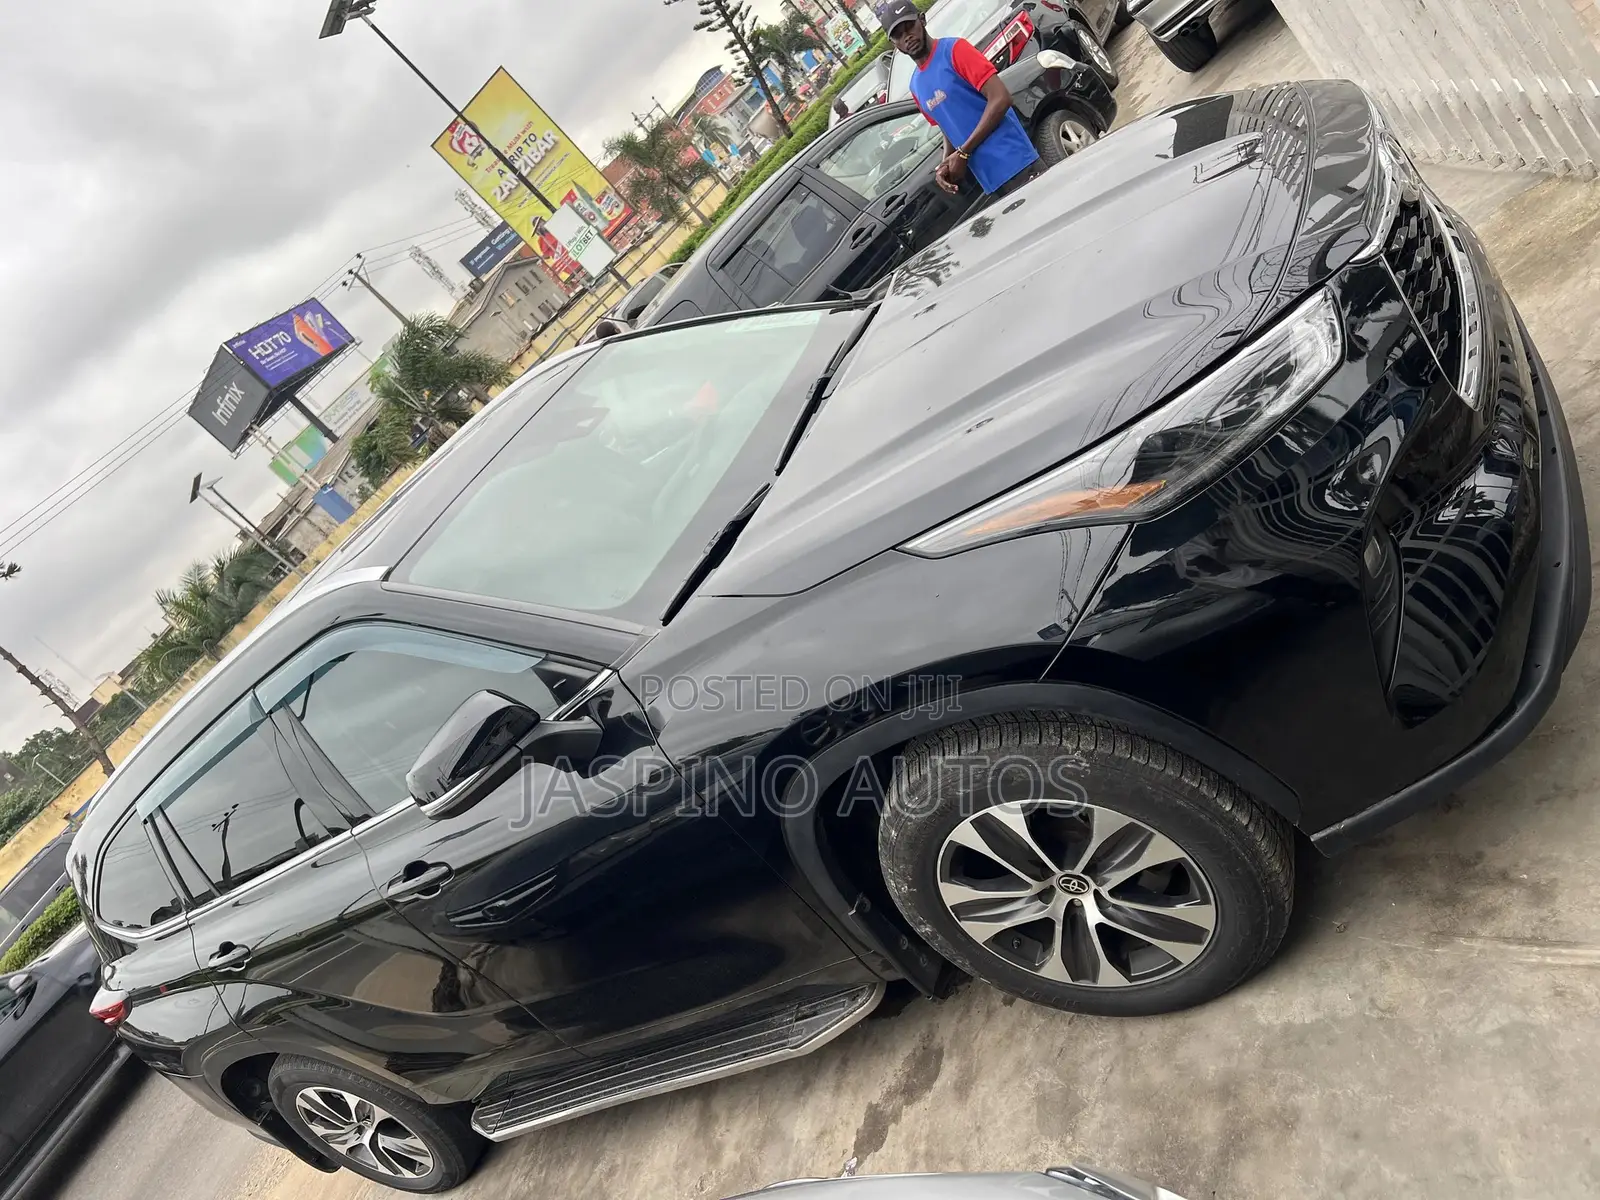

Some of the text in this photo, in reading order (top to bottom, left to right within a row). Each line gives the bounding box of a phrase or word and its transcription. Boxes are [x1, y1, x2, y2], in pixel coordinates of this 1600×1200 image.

[497, 132, 537, 178] A RIP TO
[211, 381, 245, 426] Infinix
